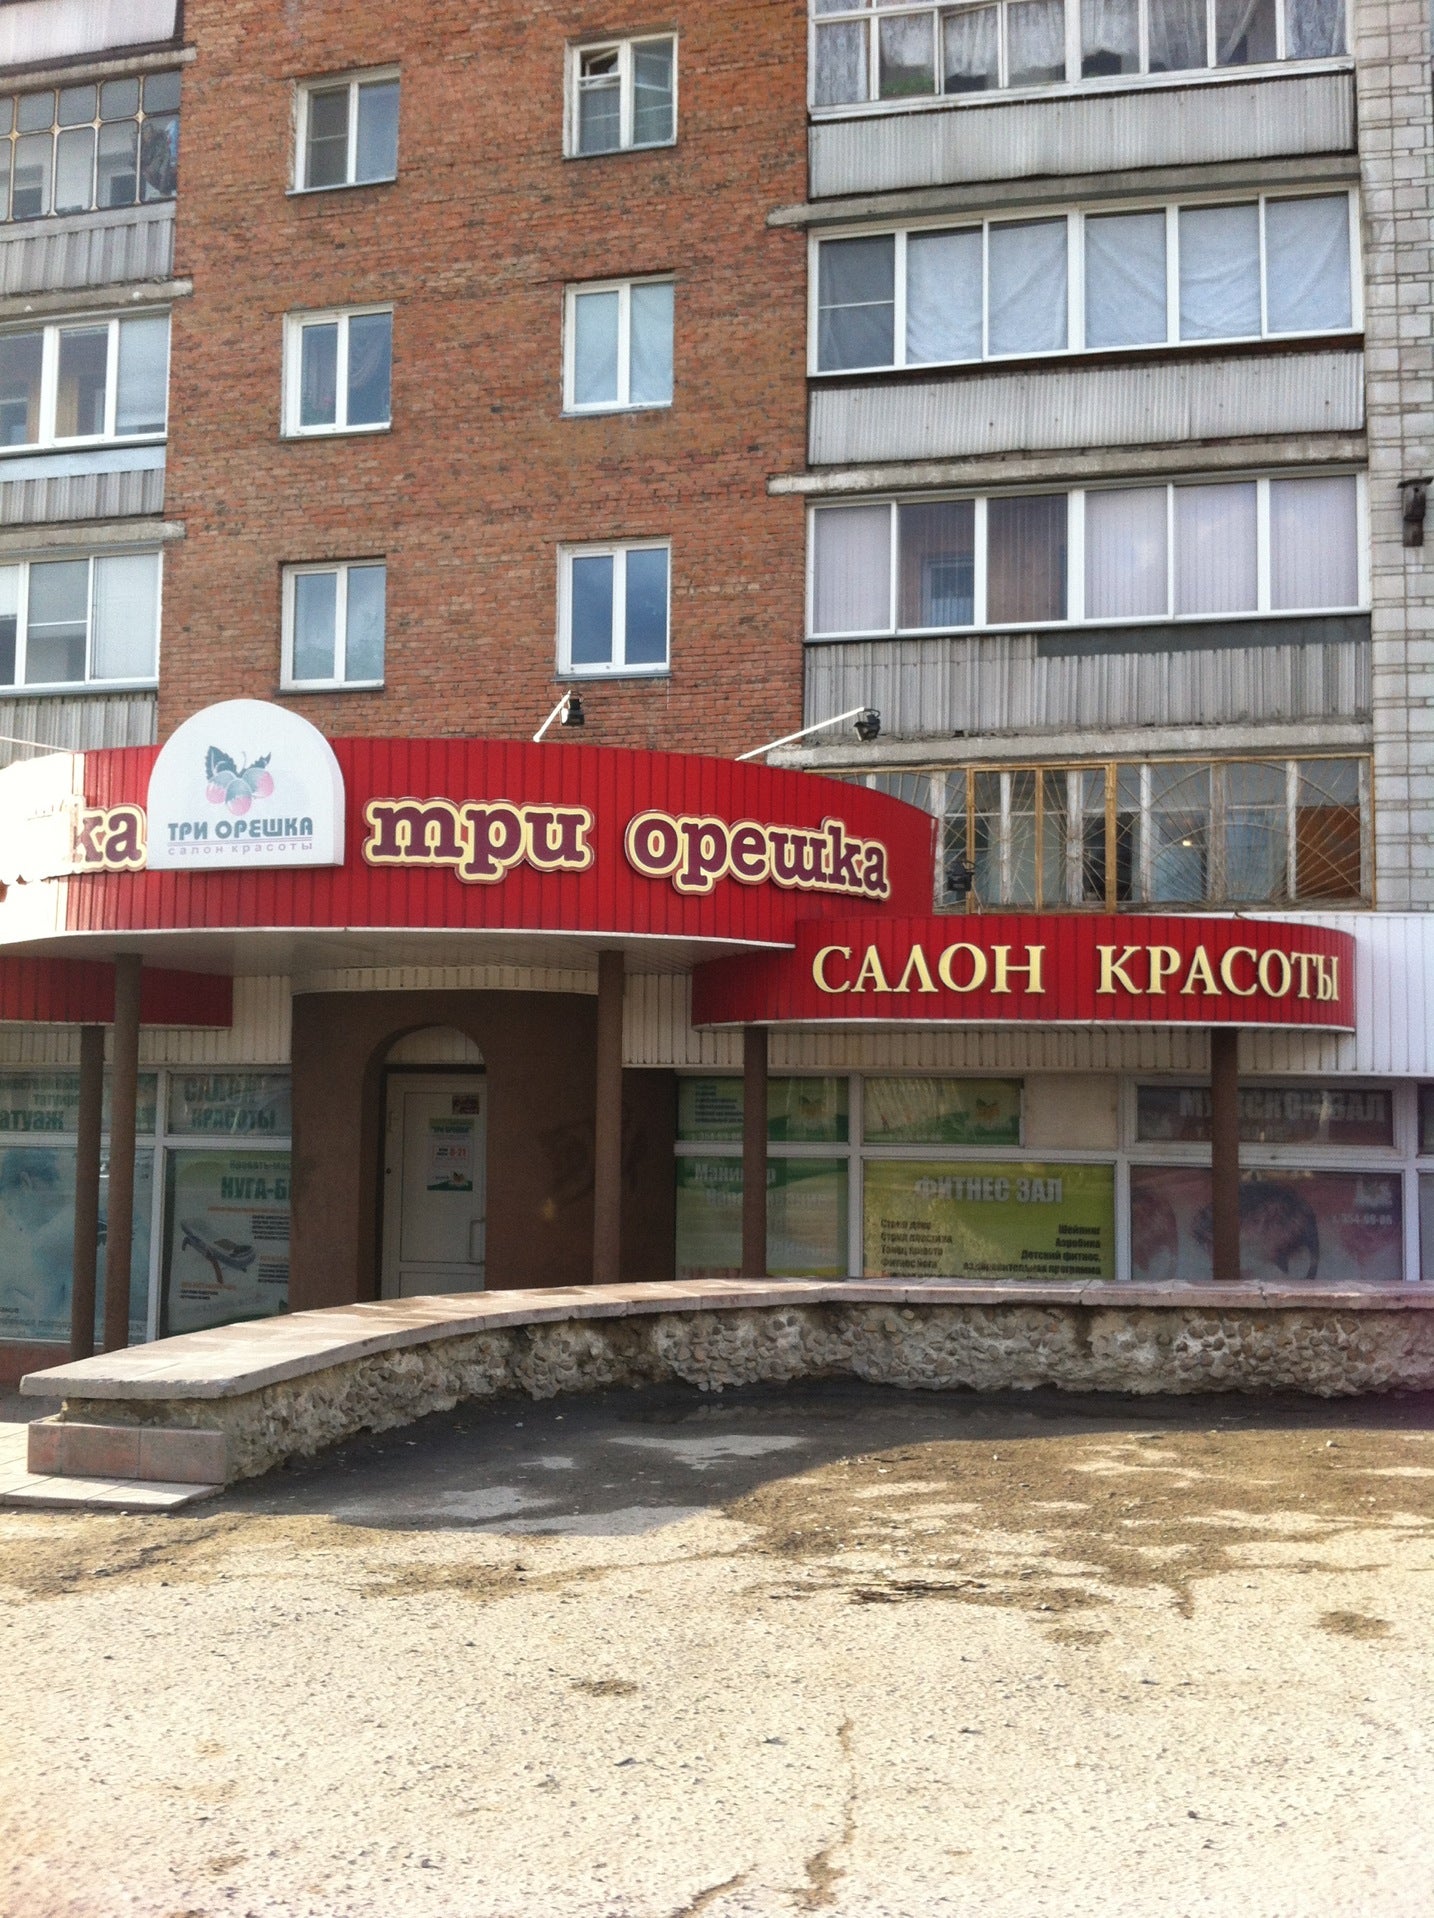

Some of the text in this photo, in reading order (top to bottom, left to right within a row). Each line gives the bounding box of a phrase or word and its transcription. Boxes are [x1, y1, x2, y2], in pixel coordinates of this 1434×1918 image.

[167, 816, 313, 841] ТРИ ОРЕШКА
[167, 842, 313, 856] салон красоты
[368, 801, 890, 893] три орешка
[811, 942, 1340, 1001] САЛОН КРАСОТЫ
[914, 1175, 1063, 1204] ФИТНЕС ЗАЛ
